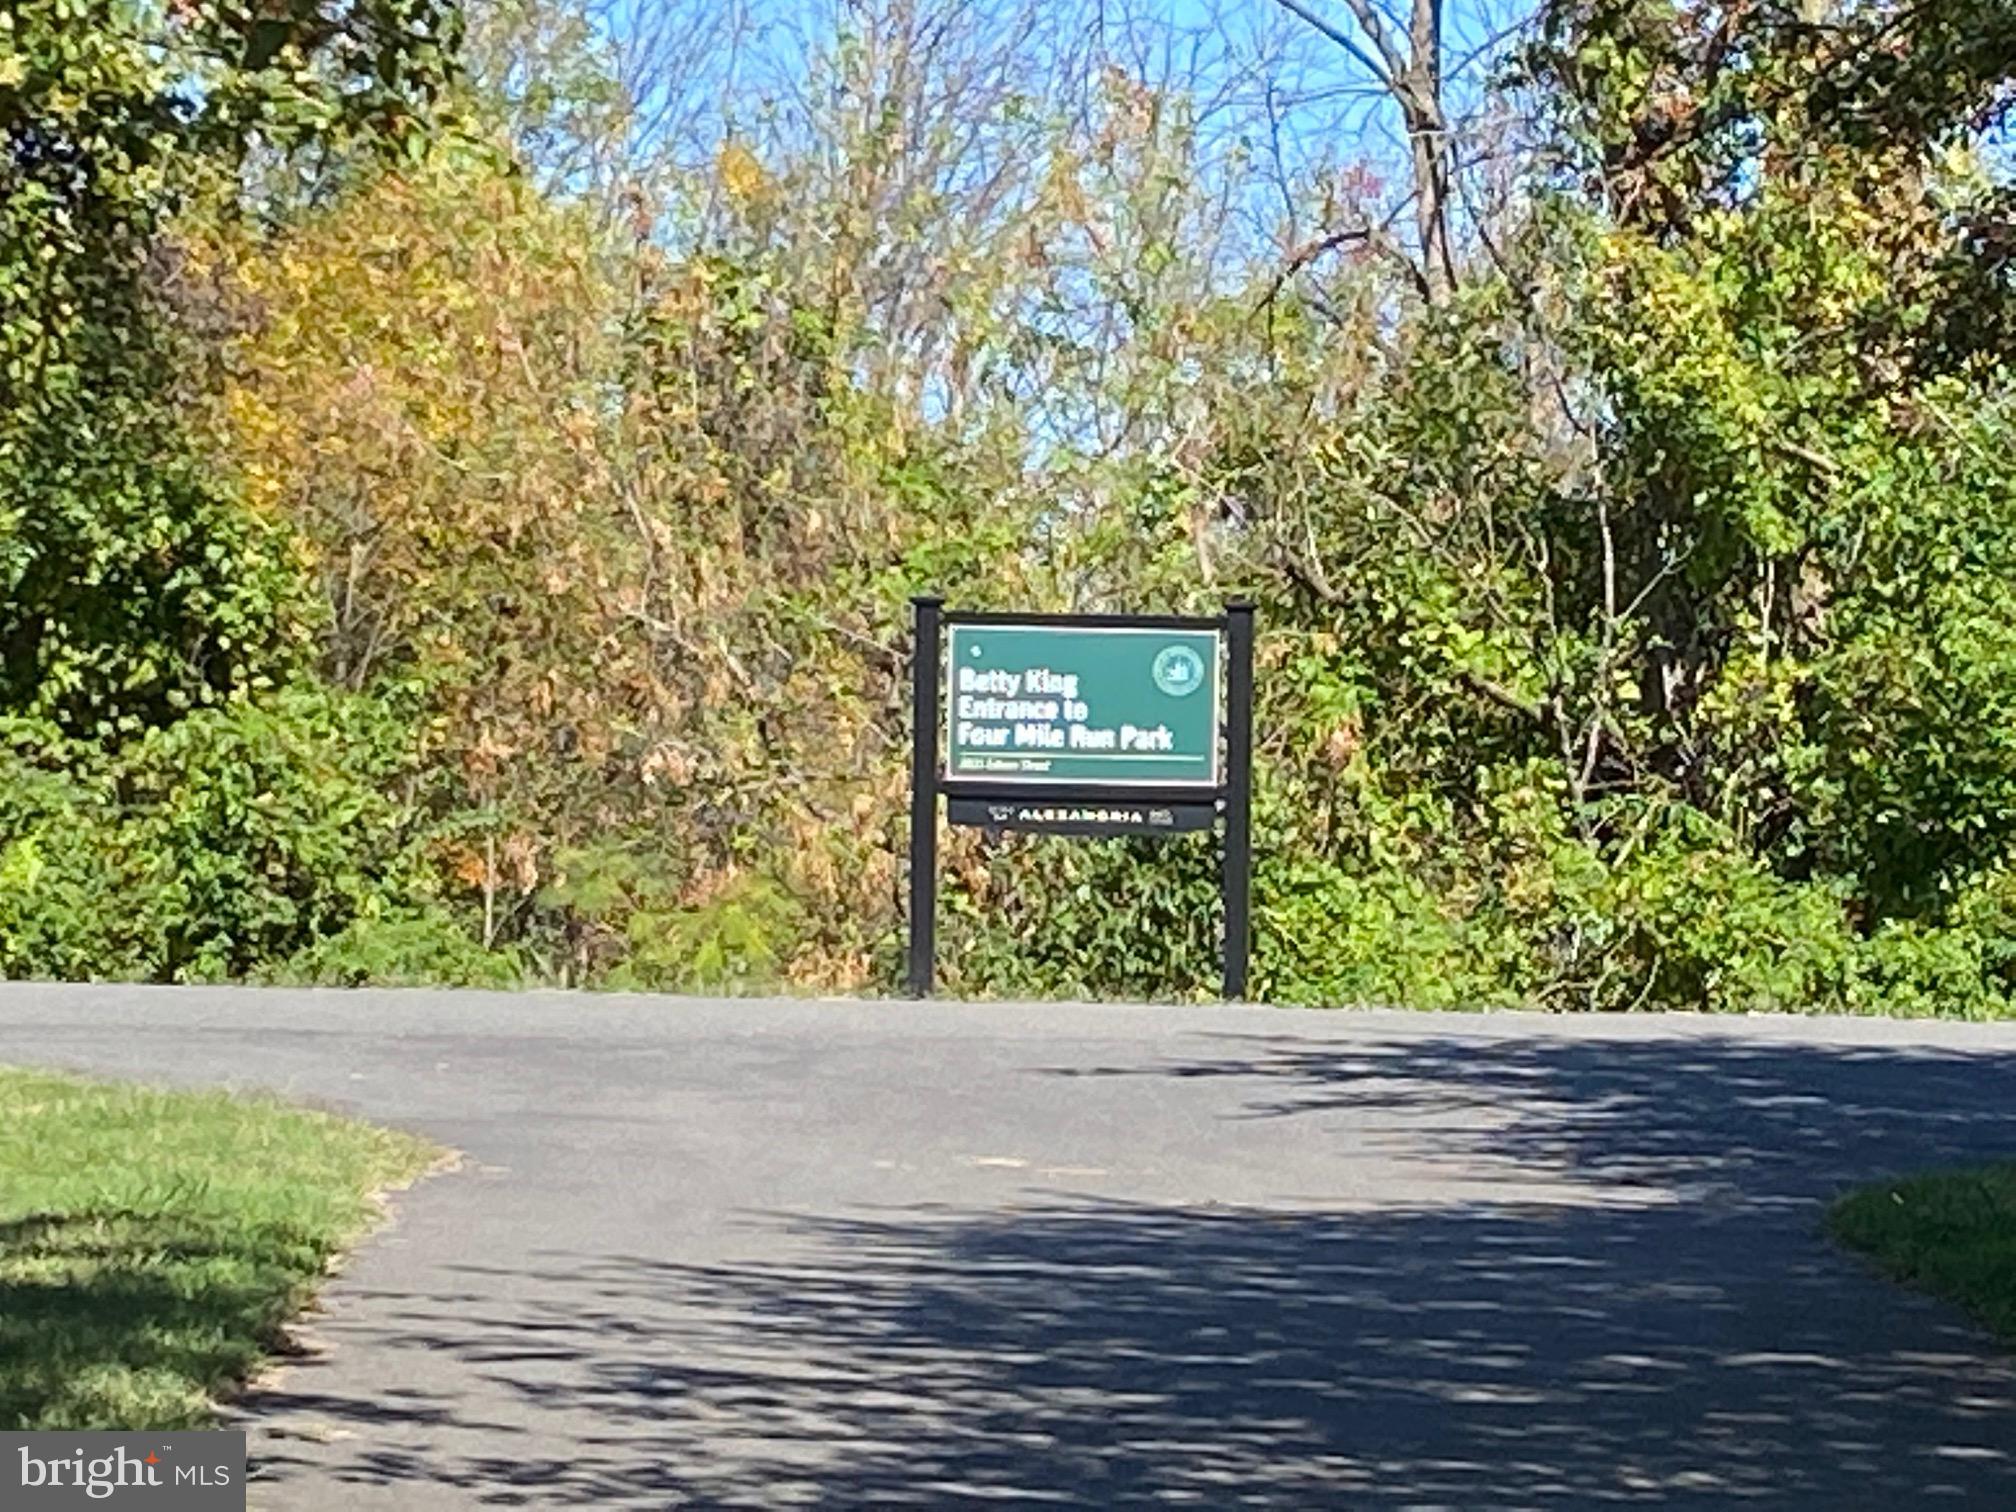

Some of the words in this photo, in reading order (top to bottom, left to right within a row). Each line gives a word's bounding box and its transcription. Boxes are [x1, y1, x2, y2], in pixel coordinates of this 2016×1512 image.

[959, 667, 1021, 697] Betty
[1026, 668, 1078, 699] King
[959, 695, 1059, 720] Entrance
[1063, 699, 1088, 721] to
[958, 721, 1010, 746] Four
[1014, 722, 1064, 748] Mile
[1069, 724, 1115, 749] Run
[1120, 724, 1174, 750] Park
